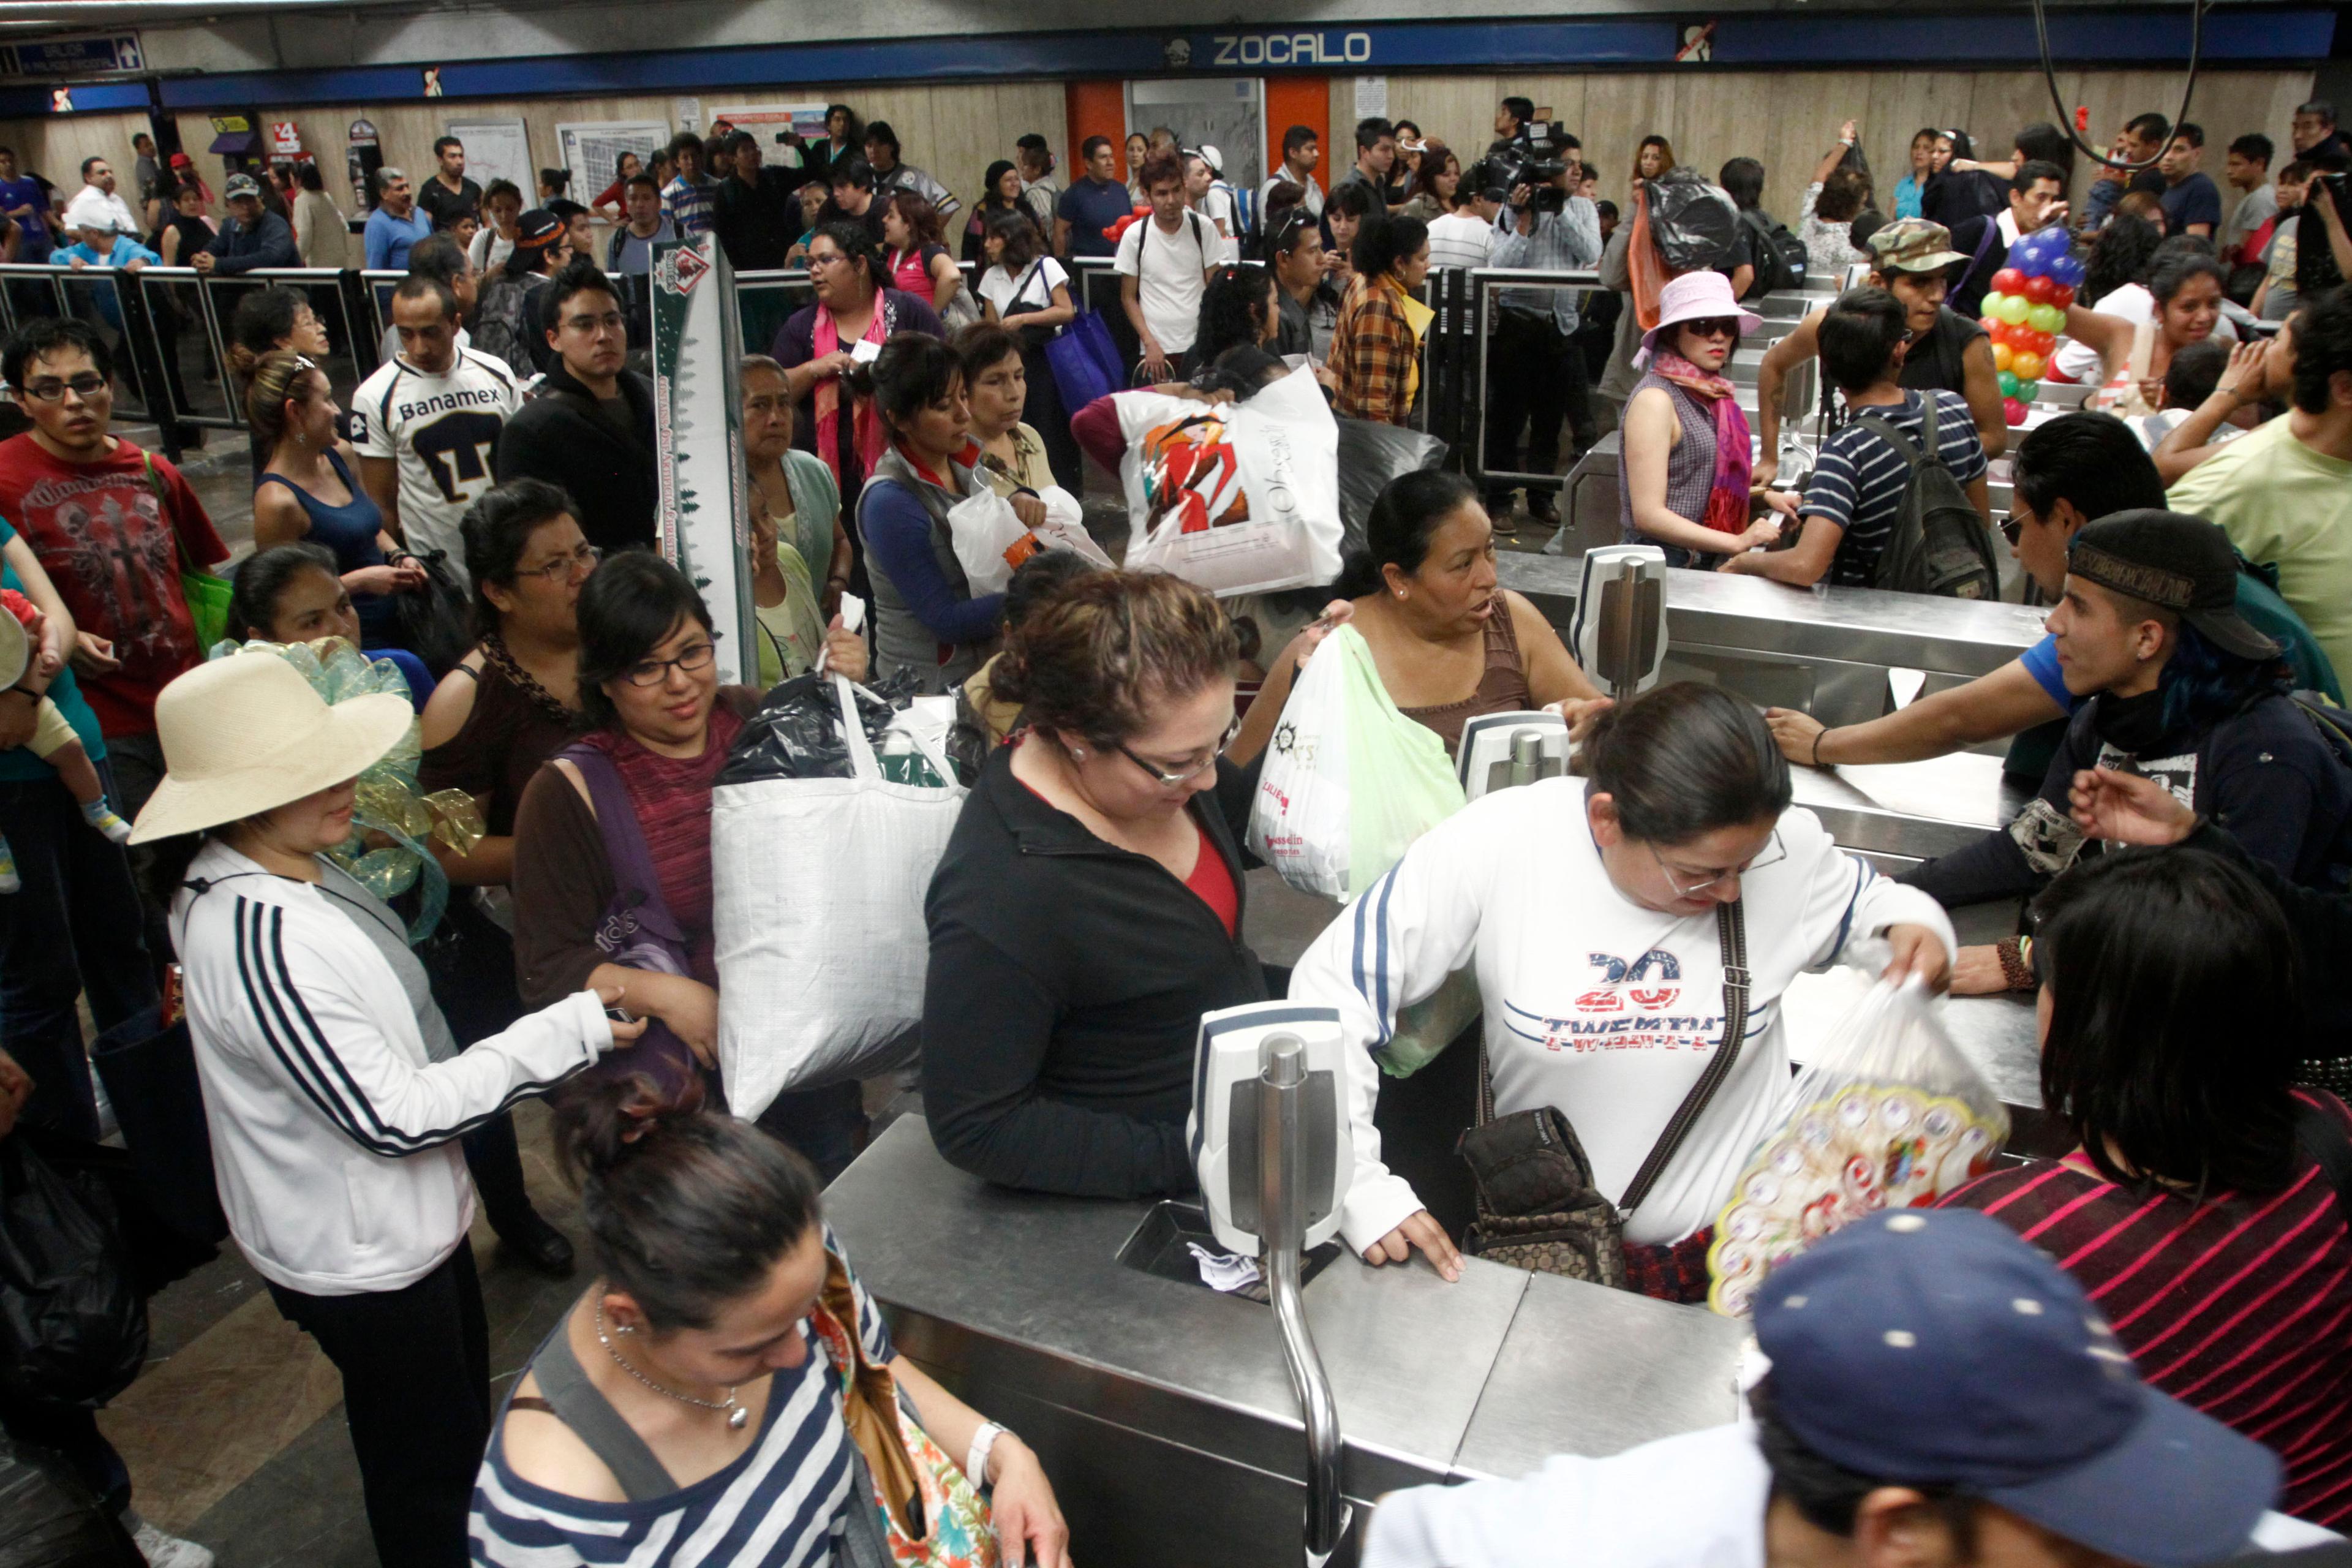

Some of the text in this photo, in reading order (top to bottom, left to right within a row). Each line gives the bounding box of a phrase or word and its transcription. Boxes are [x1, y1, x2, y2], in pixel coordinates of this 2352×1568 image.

[1214, 32, 1371, 64] ZOCALO
[399, 389, 500, 421] Banamex
[1575, 946, 1683, 1012] 20
